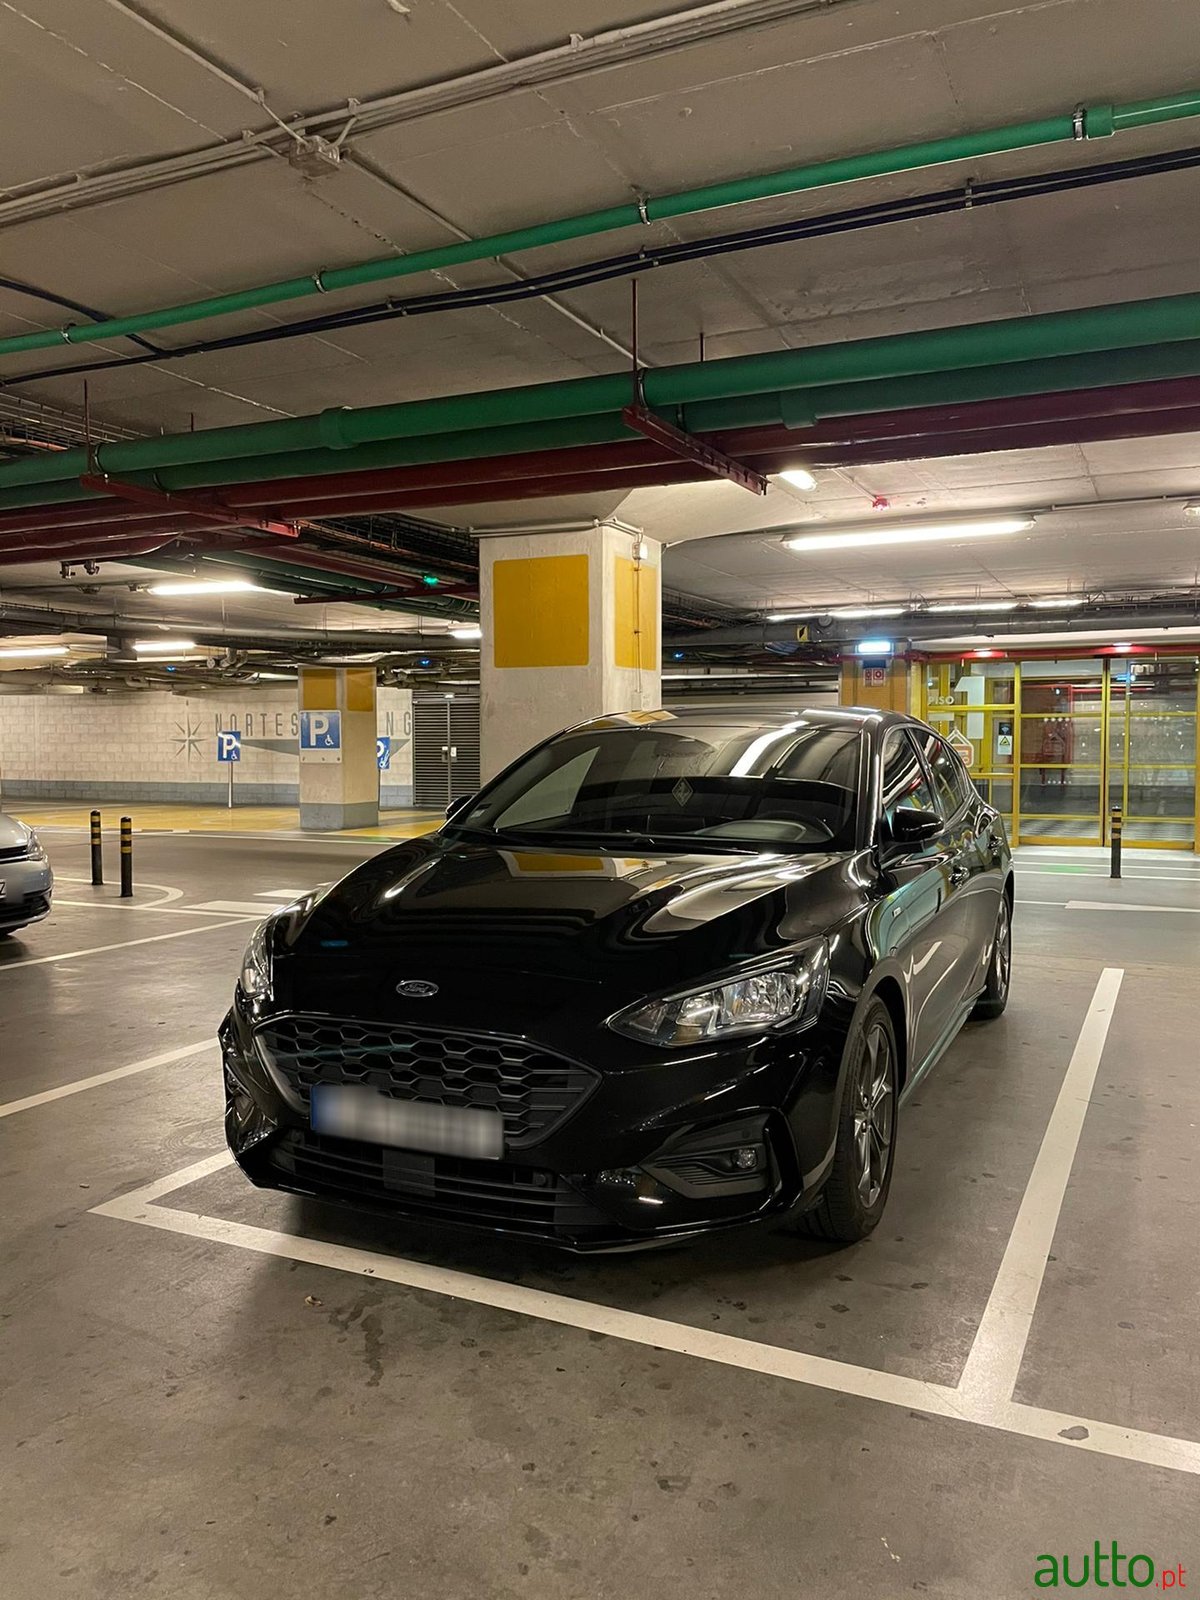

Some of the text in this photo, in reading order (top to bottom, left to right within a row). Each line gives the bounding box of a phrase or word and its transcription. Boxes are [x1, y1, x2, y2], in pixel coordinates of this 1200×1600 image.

[928, 676, 985, 739] PISO 1
[310, 716, 329, 746] P
[222, 734, 237, 759] P
